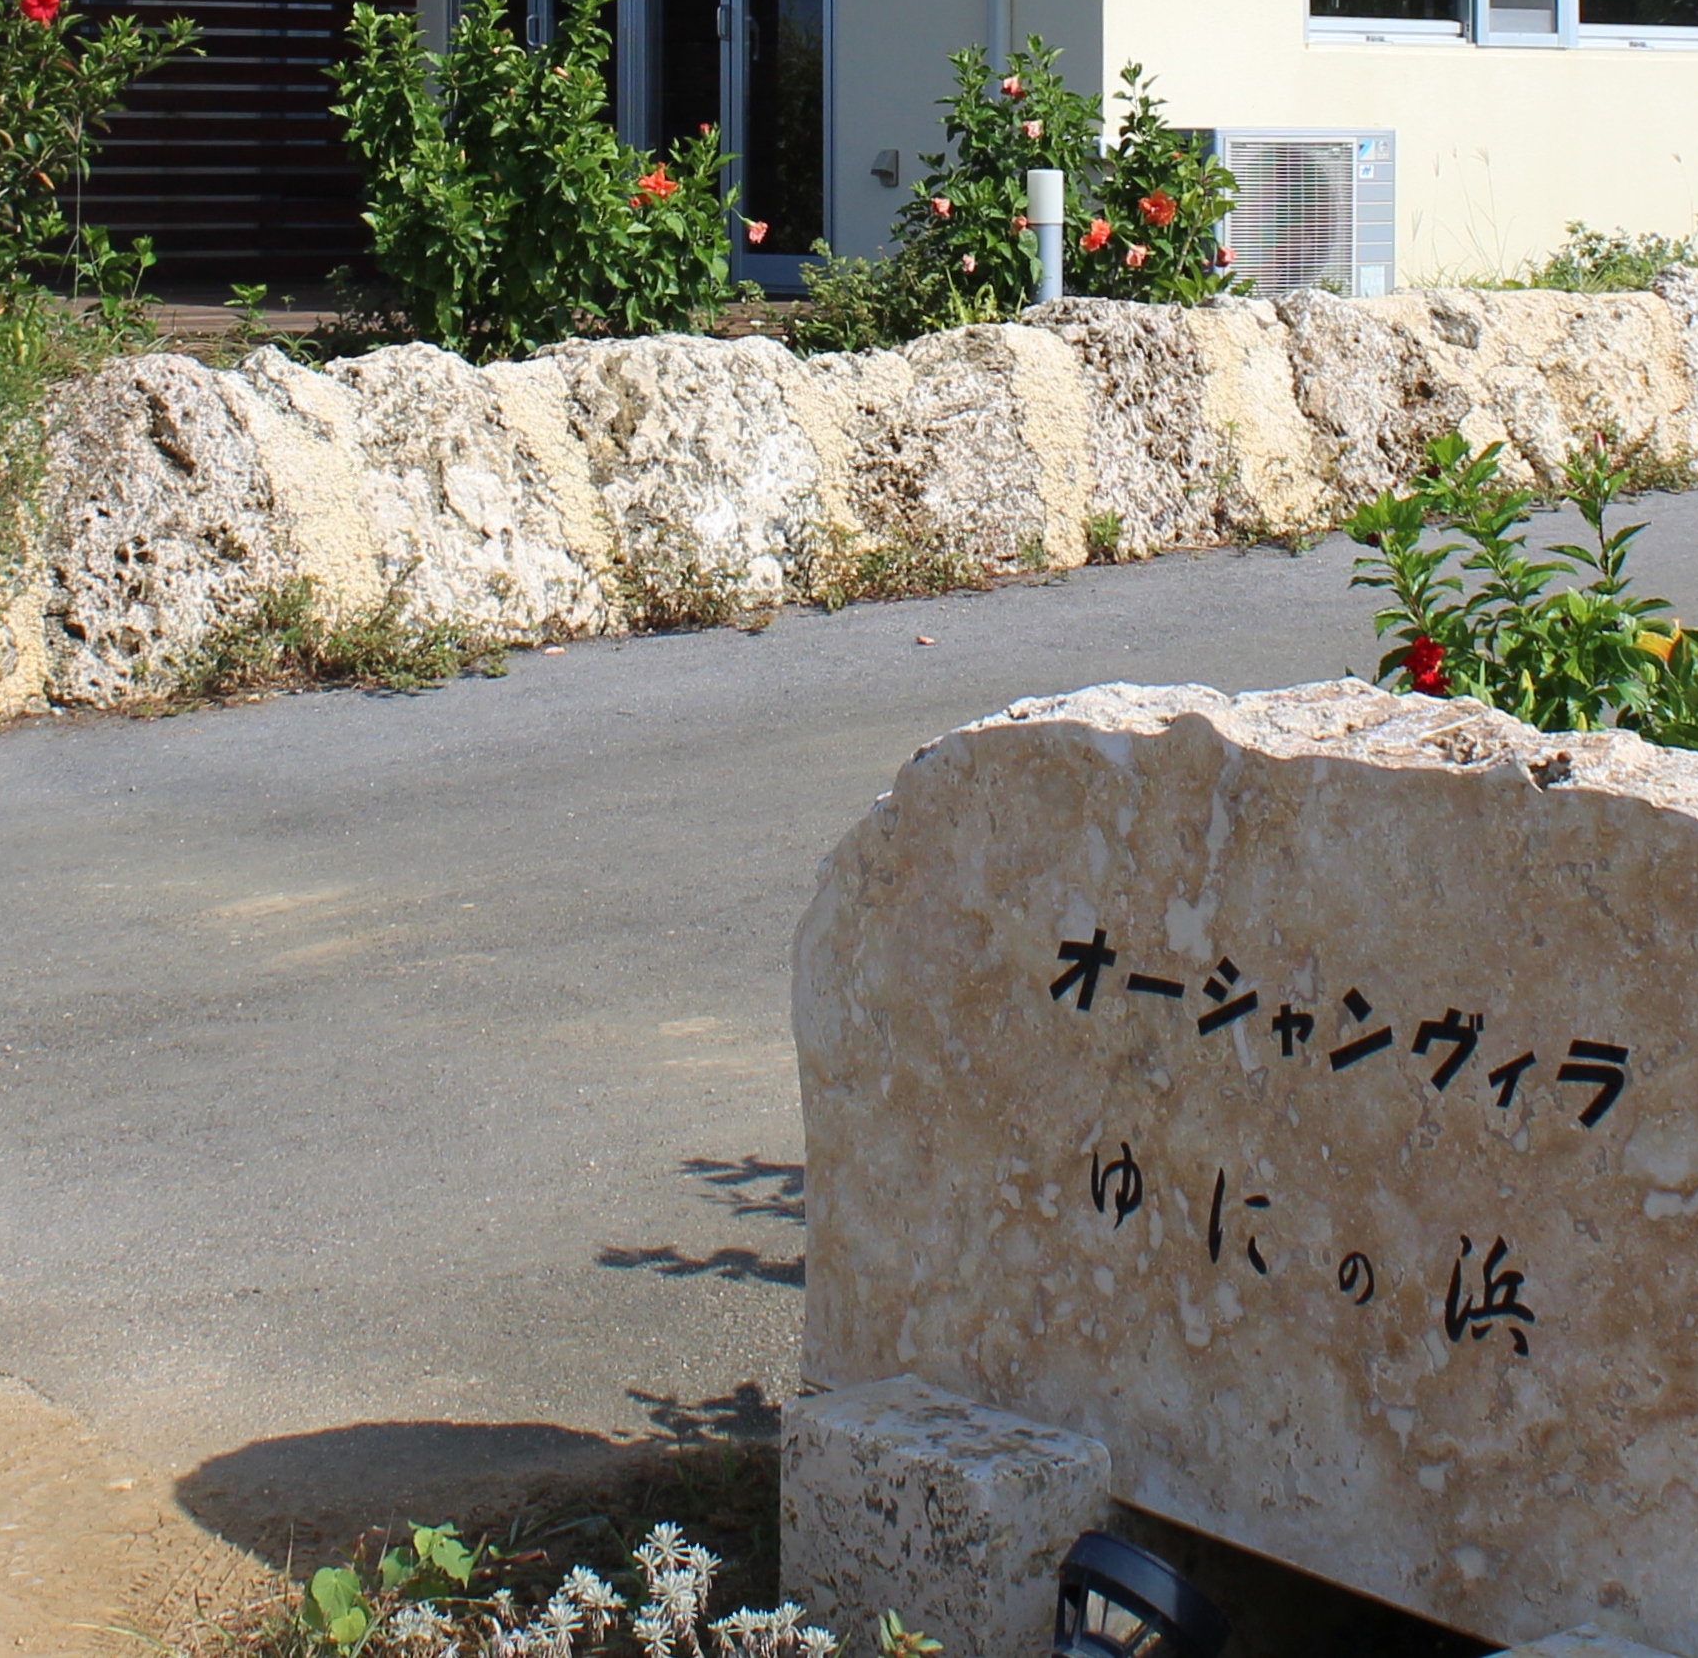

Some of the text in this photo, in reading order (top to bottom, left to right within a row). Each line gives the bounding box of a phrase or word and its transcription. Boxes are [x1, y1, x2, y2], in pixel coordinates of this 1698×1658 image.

[1048, 927, 1629, 1129] オーシャンヴィラ
